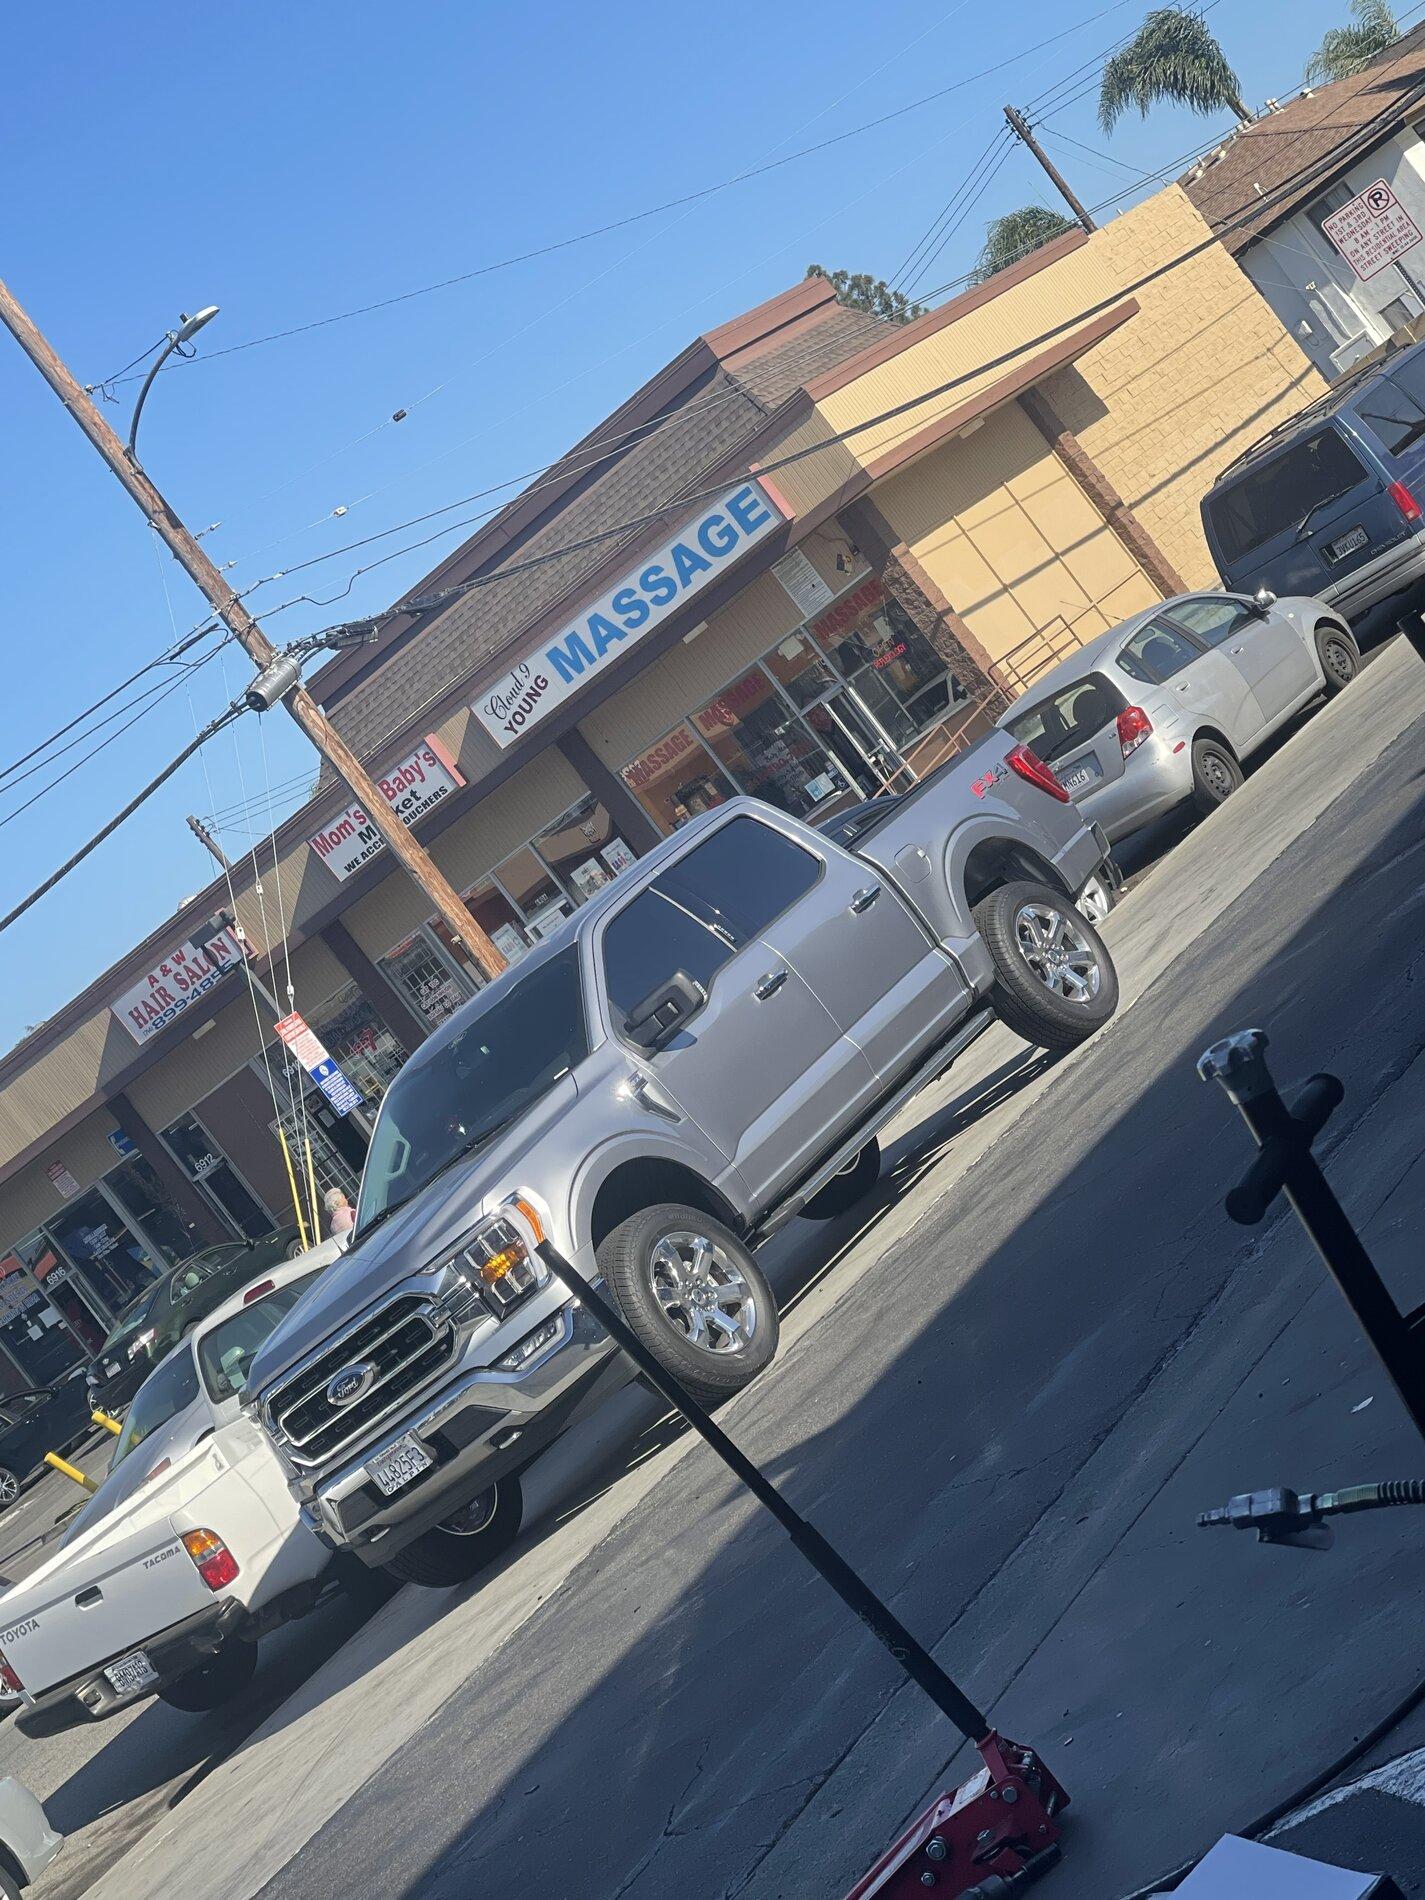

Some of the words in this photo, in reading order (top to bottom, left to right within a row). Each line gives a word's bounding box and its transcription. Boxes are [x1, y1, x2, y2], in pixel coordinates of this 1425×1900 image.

[1328, 221, 1337, 231] NO
[1338, 202, 1364, 223] PARKING
[1334, 226, 1345, 236] 1ST
[1352, 210, 1366, 223] 3RD
[1338, 216, 1373, 244] WEDNESDAY
[1349, 247, 1359, 257] ON
[1359, 237, 1372, 250] ANY
[1373, 221, 1395, 240] STREET
[1395, 214, 1403, 222] IN
[1359, 229, 1369, 239] AM
[1379, 214, 1389, 224] PM
[1353, 254, 1365, 265] THIS
[1365, 230, 1397, 256] RESIDENTIAL
[1396, 220, 1411, 234] AREA
[1360, 252, 1382, 271] STREET
[1383, 229, 1413, 254] SWEEPING
[545, 486, 772, 684] MASSAGE
[871, 635, 895, 657] OPEN
[484, 671, 525, 720] Cloud
[519, 662, 530, 679] 9
[504, 675, 549, 735] YOUNG
[969, 760, 1007, 801] FX4
[311, 807, 368, 858] Mom's
[377, 750, 437, 802] Baby's
[357, 787, 421, 845] Mket
[401, 785, 448, 825] OUCHERS
[343, 856, 361, 873] WE
[127, 983, 176, 1030] HAIR
[171, 936, 231, 993] SALON
[145, 972, 159, 988] A
[158, 962, 172, 977] &
[170, 949, 187, 967] W
[193, 1152, 215, 1172] 6912
[45, 1265, 66, 1285] 6916
[334, 1377, 359, 1398] Ford
[377, 1445, 425, 1487] 44825F3
[142, 1545, 181, 1570] TACOMA
[0, 1618, 40, 1645] TOYOTA
